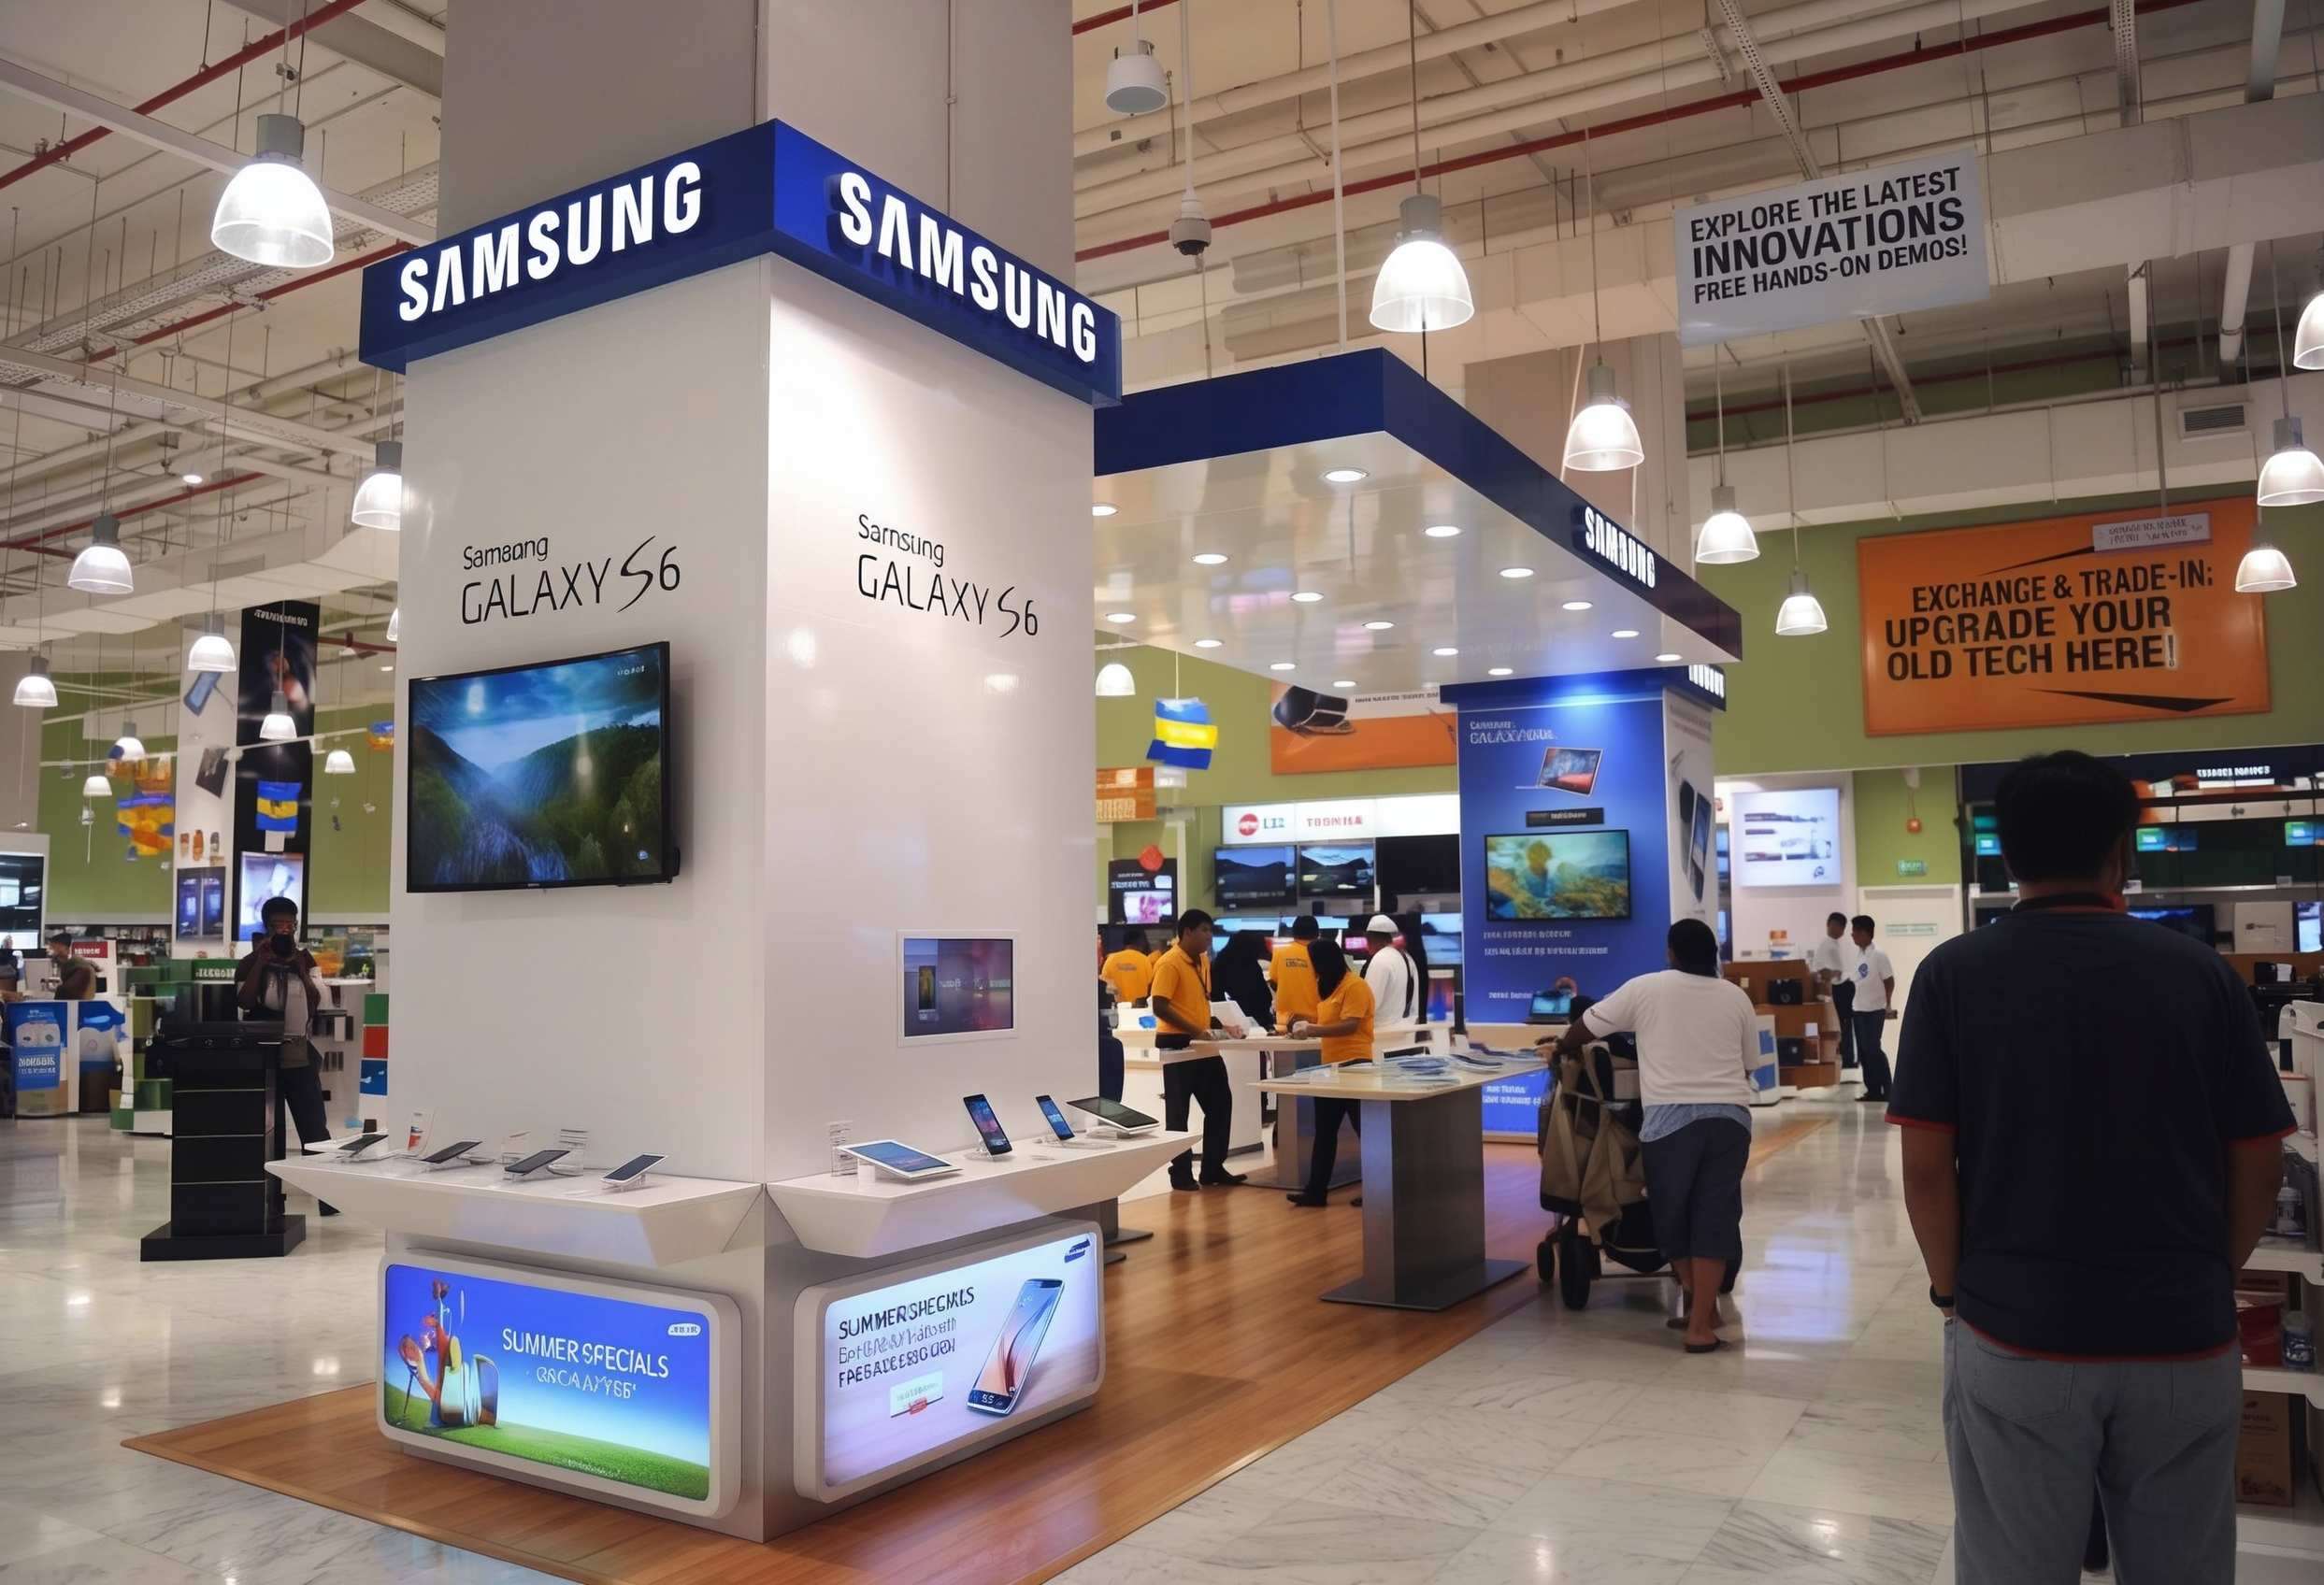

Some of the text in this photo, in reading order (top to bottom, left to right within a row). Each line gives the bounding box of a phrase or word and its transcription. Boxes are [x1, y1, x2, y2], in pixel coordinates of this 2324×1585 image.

[398, 161, 702, 323] SAMSUNG
[1690, 166, 1960, 243] EXPLORE THE LATEST
[1693, 197, 1965, 278] INNOVATIONS
[838, 171, 1097, 364] SAMSUNG
[1694, 234, 1969, 304] FREE HANDS-ON DEMOS!
[462, 535, 681, 624] GALAXY S6
[858, 553, 1039, 638] GALAXY S6
[1912, 575, 2046, 613] EXCHANGE
[2053, 574, 2073, 599] &
[1885, 595, 2172, 648] UPGRADE YOUR
[1886, 634, 2175, 680] OLD TECH HERE!
[501, 1327, 580, 1364] SUMMER
